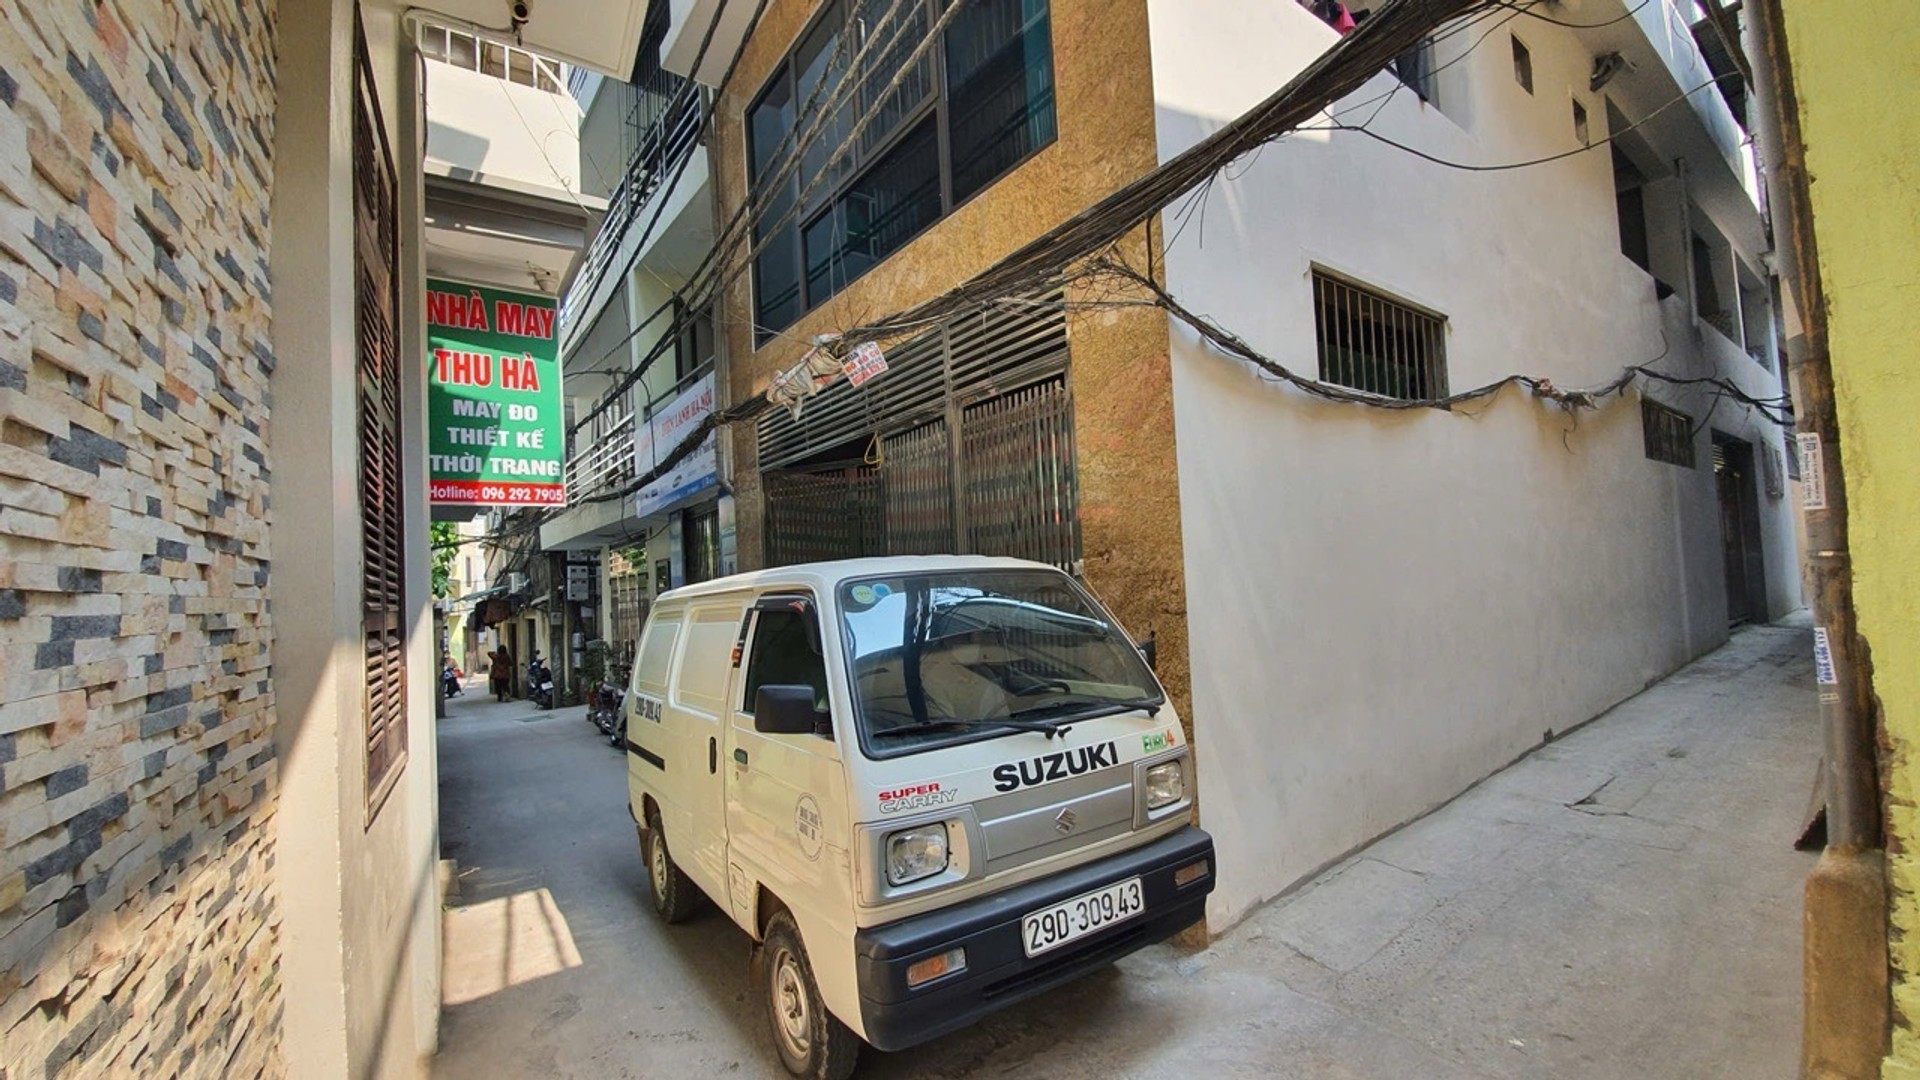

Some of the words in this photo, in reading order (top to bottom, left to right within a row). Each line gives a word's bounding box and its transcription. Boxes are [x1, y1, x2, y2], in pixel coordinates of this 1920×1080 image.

[427, 290, 489, 331] NHÀ
[496, 300, 556, 339] MAY
[434, 348, 492, 389] THU
[501, 352, 540, 392] HÀ
[453, 399, 501, 419] MAY
[508, 404, 538, 422] ĐO
[447, 424, 509, 447] THIẾT
[516, 428, 545, 449] KẾ
[430, 453, 482, 474] THỜI
[489, 457, 561, 477] TRANG
[429, 485, 478, 500] Hotline:
[482, 486, 505, 500] 096
[509, 487, 531, 501] 292
[534, 488, 563, 501] 7905
[992, 741, 1119, 793] SUZUKI
[878, 788, 958, 814] CARRY
[879, 782, 941, 802] SUPER
[1026, 882, 1142, 952] 29D-309.43
